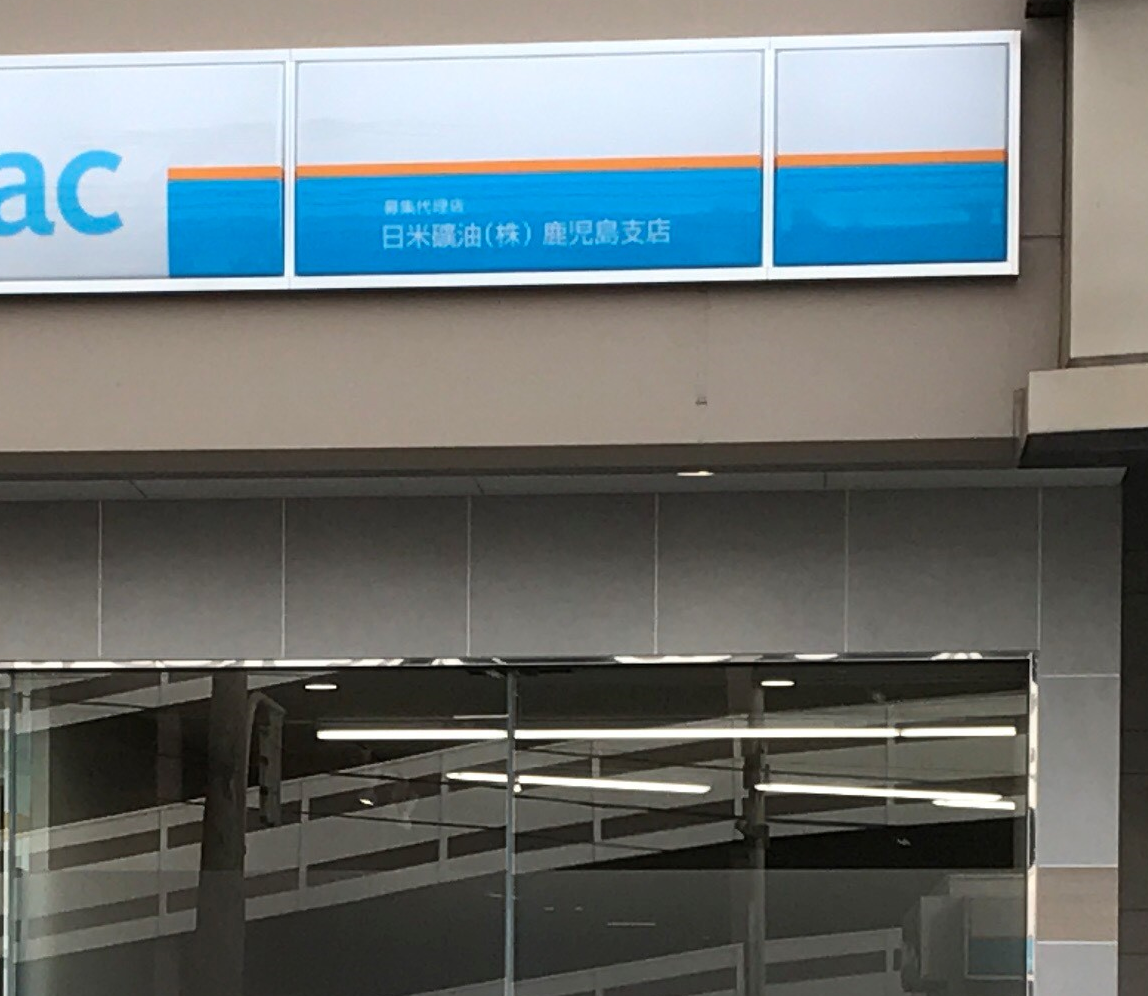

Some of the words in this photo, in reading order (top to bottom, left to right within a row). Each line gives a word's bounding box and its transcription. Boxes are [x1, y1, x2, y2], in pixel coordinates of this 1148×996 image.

[542, 218, 672, 247] 鹿児島支店
